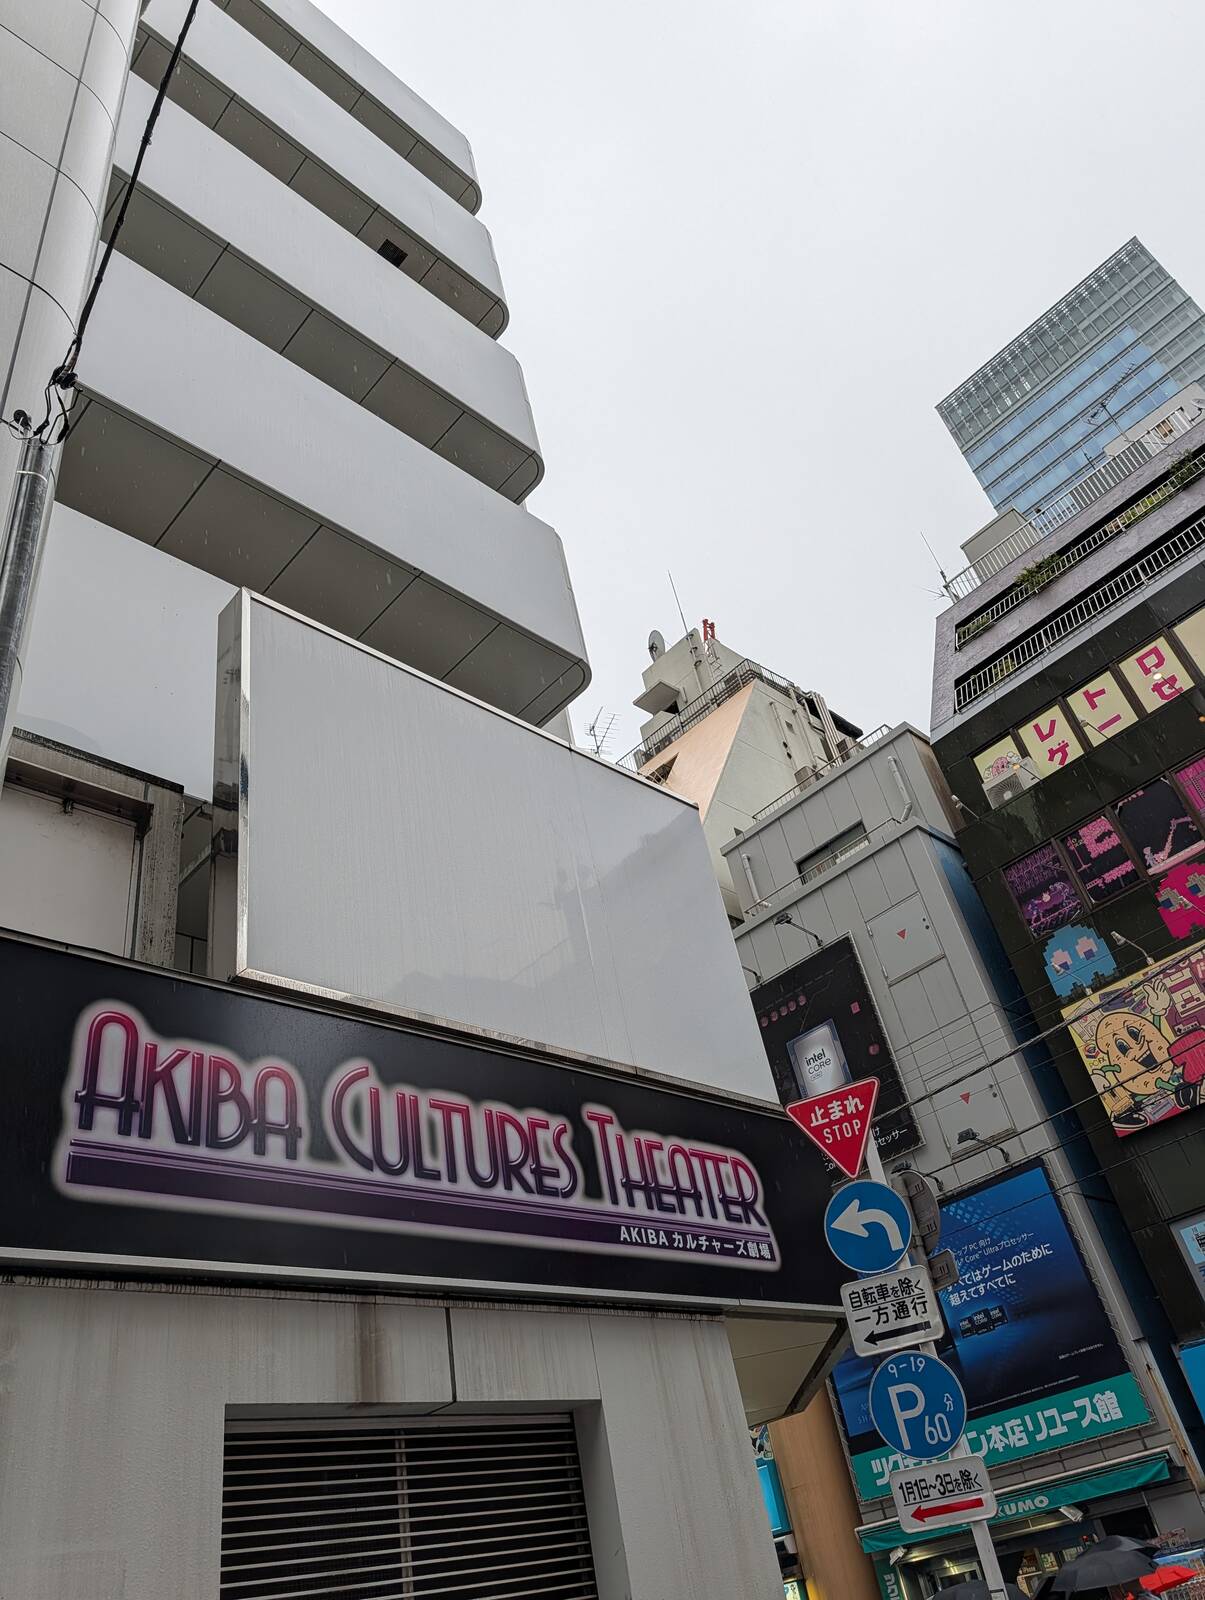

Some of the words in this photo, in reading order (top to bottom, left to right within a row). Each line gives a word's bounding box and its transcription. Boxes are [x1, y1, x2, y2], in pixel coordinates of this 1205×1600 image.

[804, 1048, 827, 1068] intel
[75, 1009, 303, 1160] AKIBA
[331, 1065, 577, 1200] CULTURES
[585, 1109, 768, 1227] THEATER
[810, 1095, 865, 1127] 止まれ
[823, 1120, 862, 1143] STOP
[875, 1128, 908, 1146] セッサー
[620, 1226, 669, 1247] AKIBA
[672, 1232, 771, 1260] カルチャーズ劇場
[849, 1277, 925, 1309] 自転車を除く
[949, 1273, 1016, 1307] 超えてすべてに
[854, 1296, 929, 1326] 一方通行
[888, 1357, 926, 1378] 9-19
[888, 1382, 926, 1450] P
[924, 1413, 952, 1445] 60
[943, 1393, 954, 1411] 分
